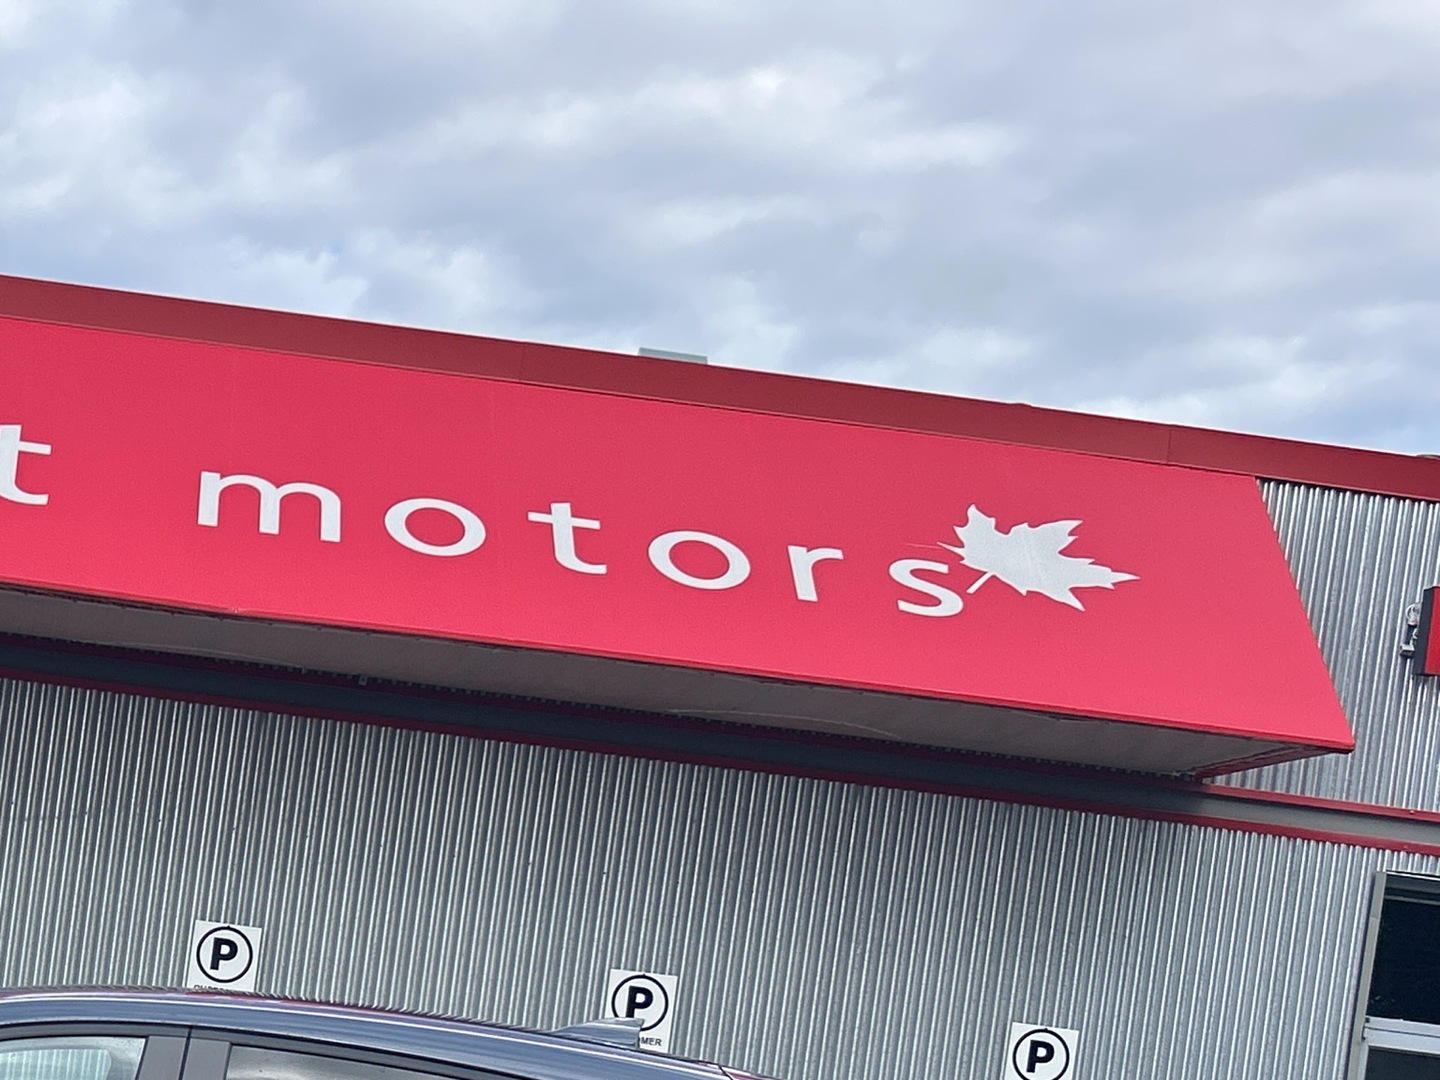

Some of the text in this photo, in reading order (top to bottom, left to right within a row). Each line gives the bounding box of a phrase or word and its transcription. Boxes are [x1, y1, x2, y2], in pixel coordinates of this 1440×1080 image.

[196, 469, 965, 618] motors
[210, 937, 238, 971] P
[625, 985, 654, 1018] P
[1026, 1039, 1055, 1073] P
